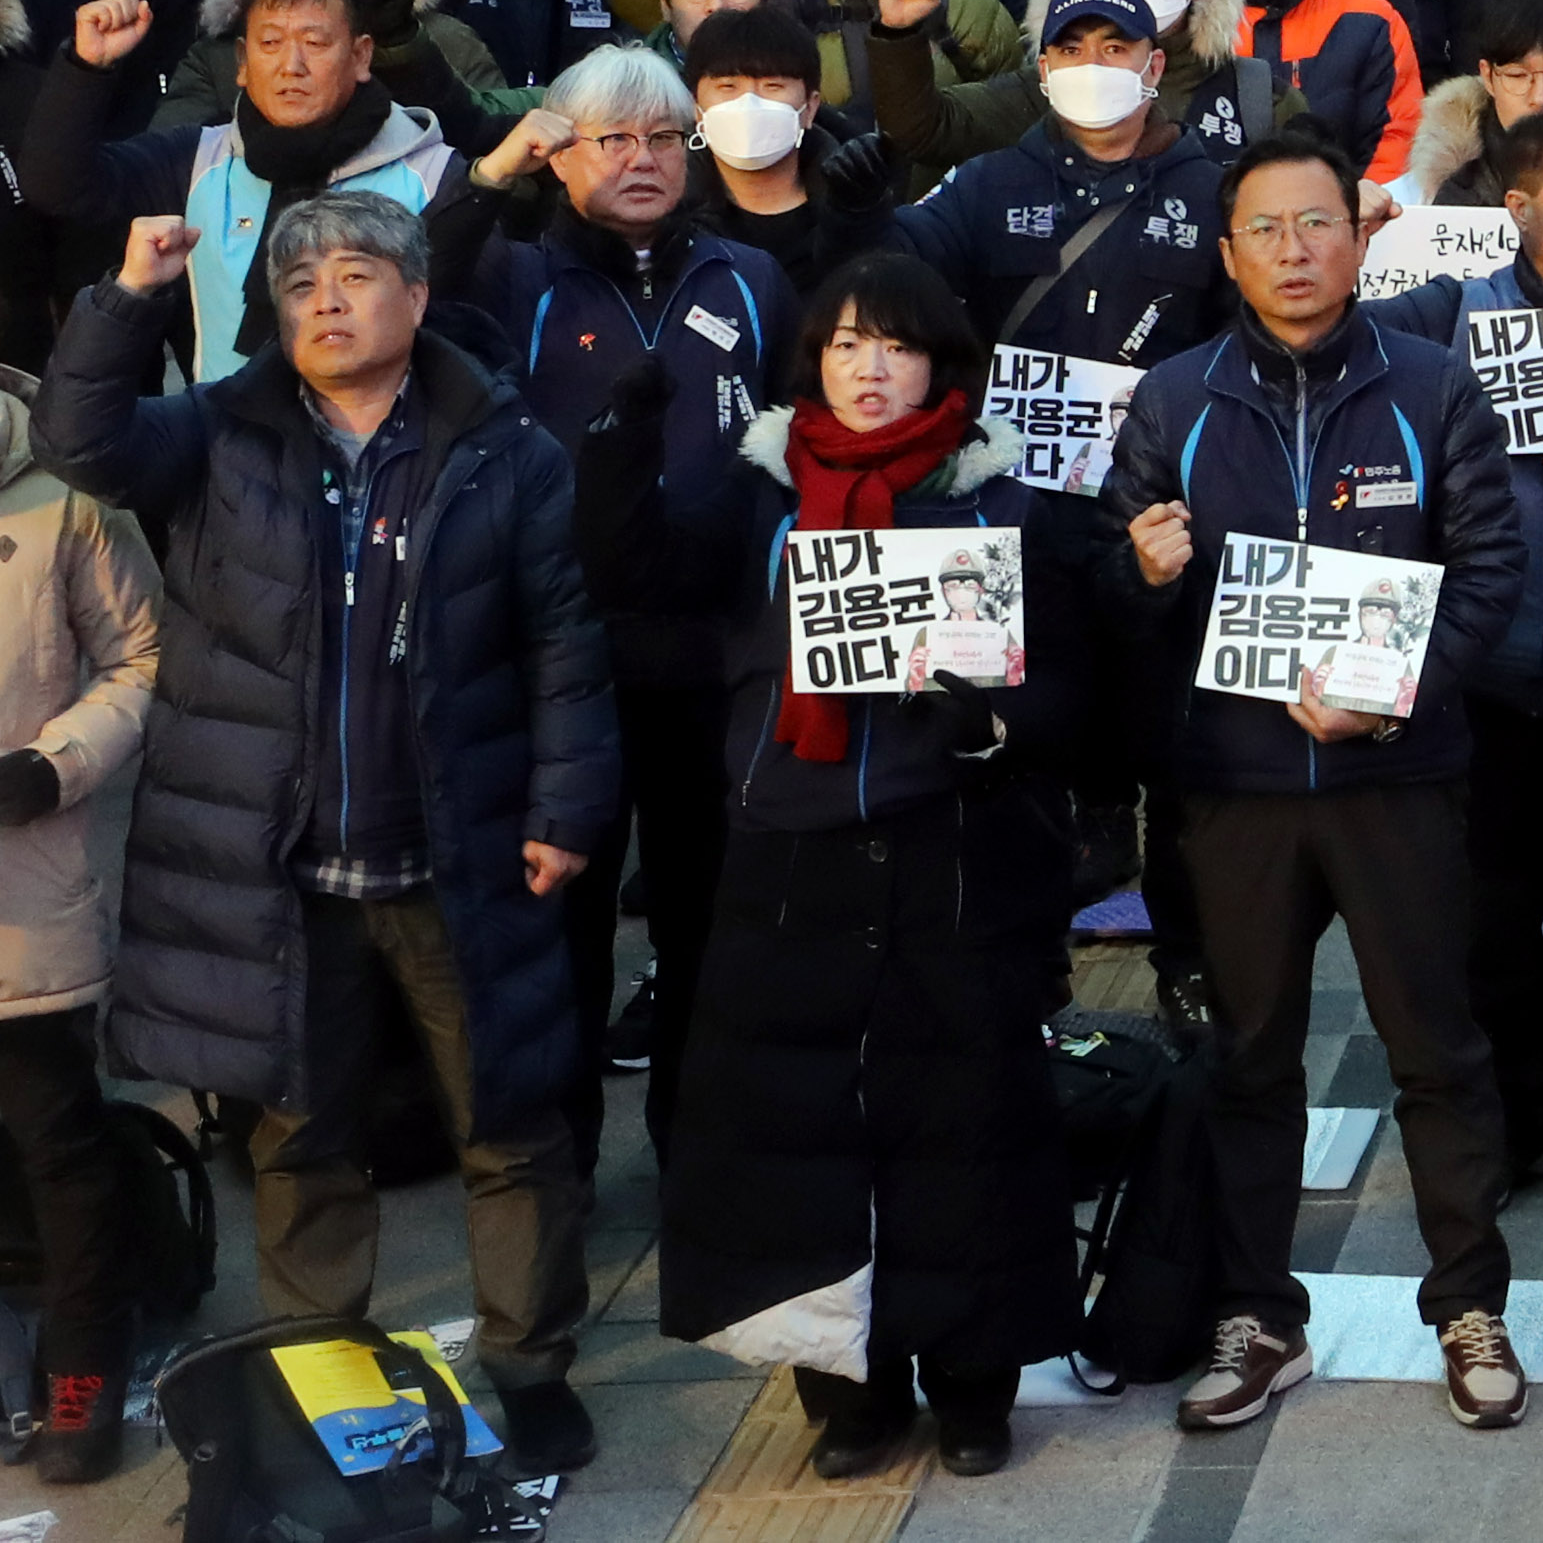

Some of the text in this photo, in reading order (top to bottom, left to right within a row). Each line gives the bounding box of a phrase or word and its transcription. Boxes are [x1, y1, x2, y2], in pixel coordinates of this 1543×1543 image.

[1199, 113, 1243, 147] 투쟁
[1006, 203, 1199, 250] 단결 투쟁
[991, 352, 1071, 394] 내가
[788, 529, 884, 585] 내가
[1222, 541, 1314, 589] 내가
[797, 575, 937, 639] 김용균
[1218, 593, 1352, 642] 김용균
[805, 635, 901, 689] 이다
[1213, 644, 1306, 691] 이다
